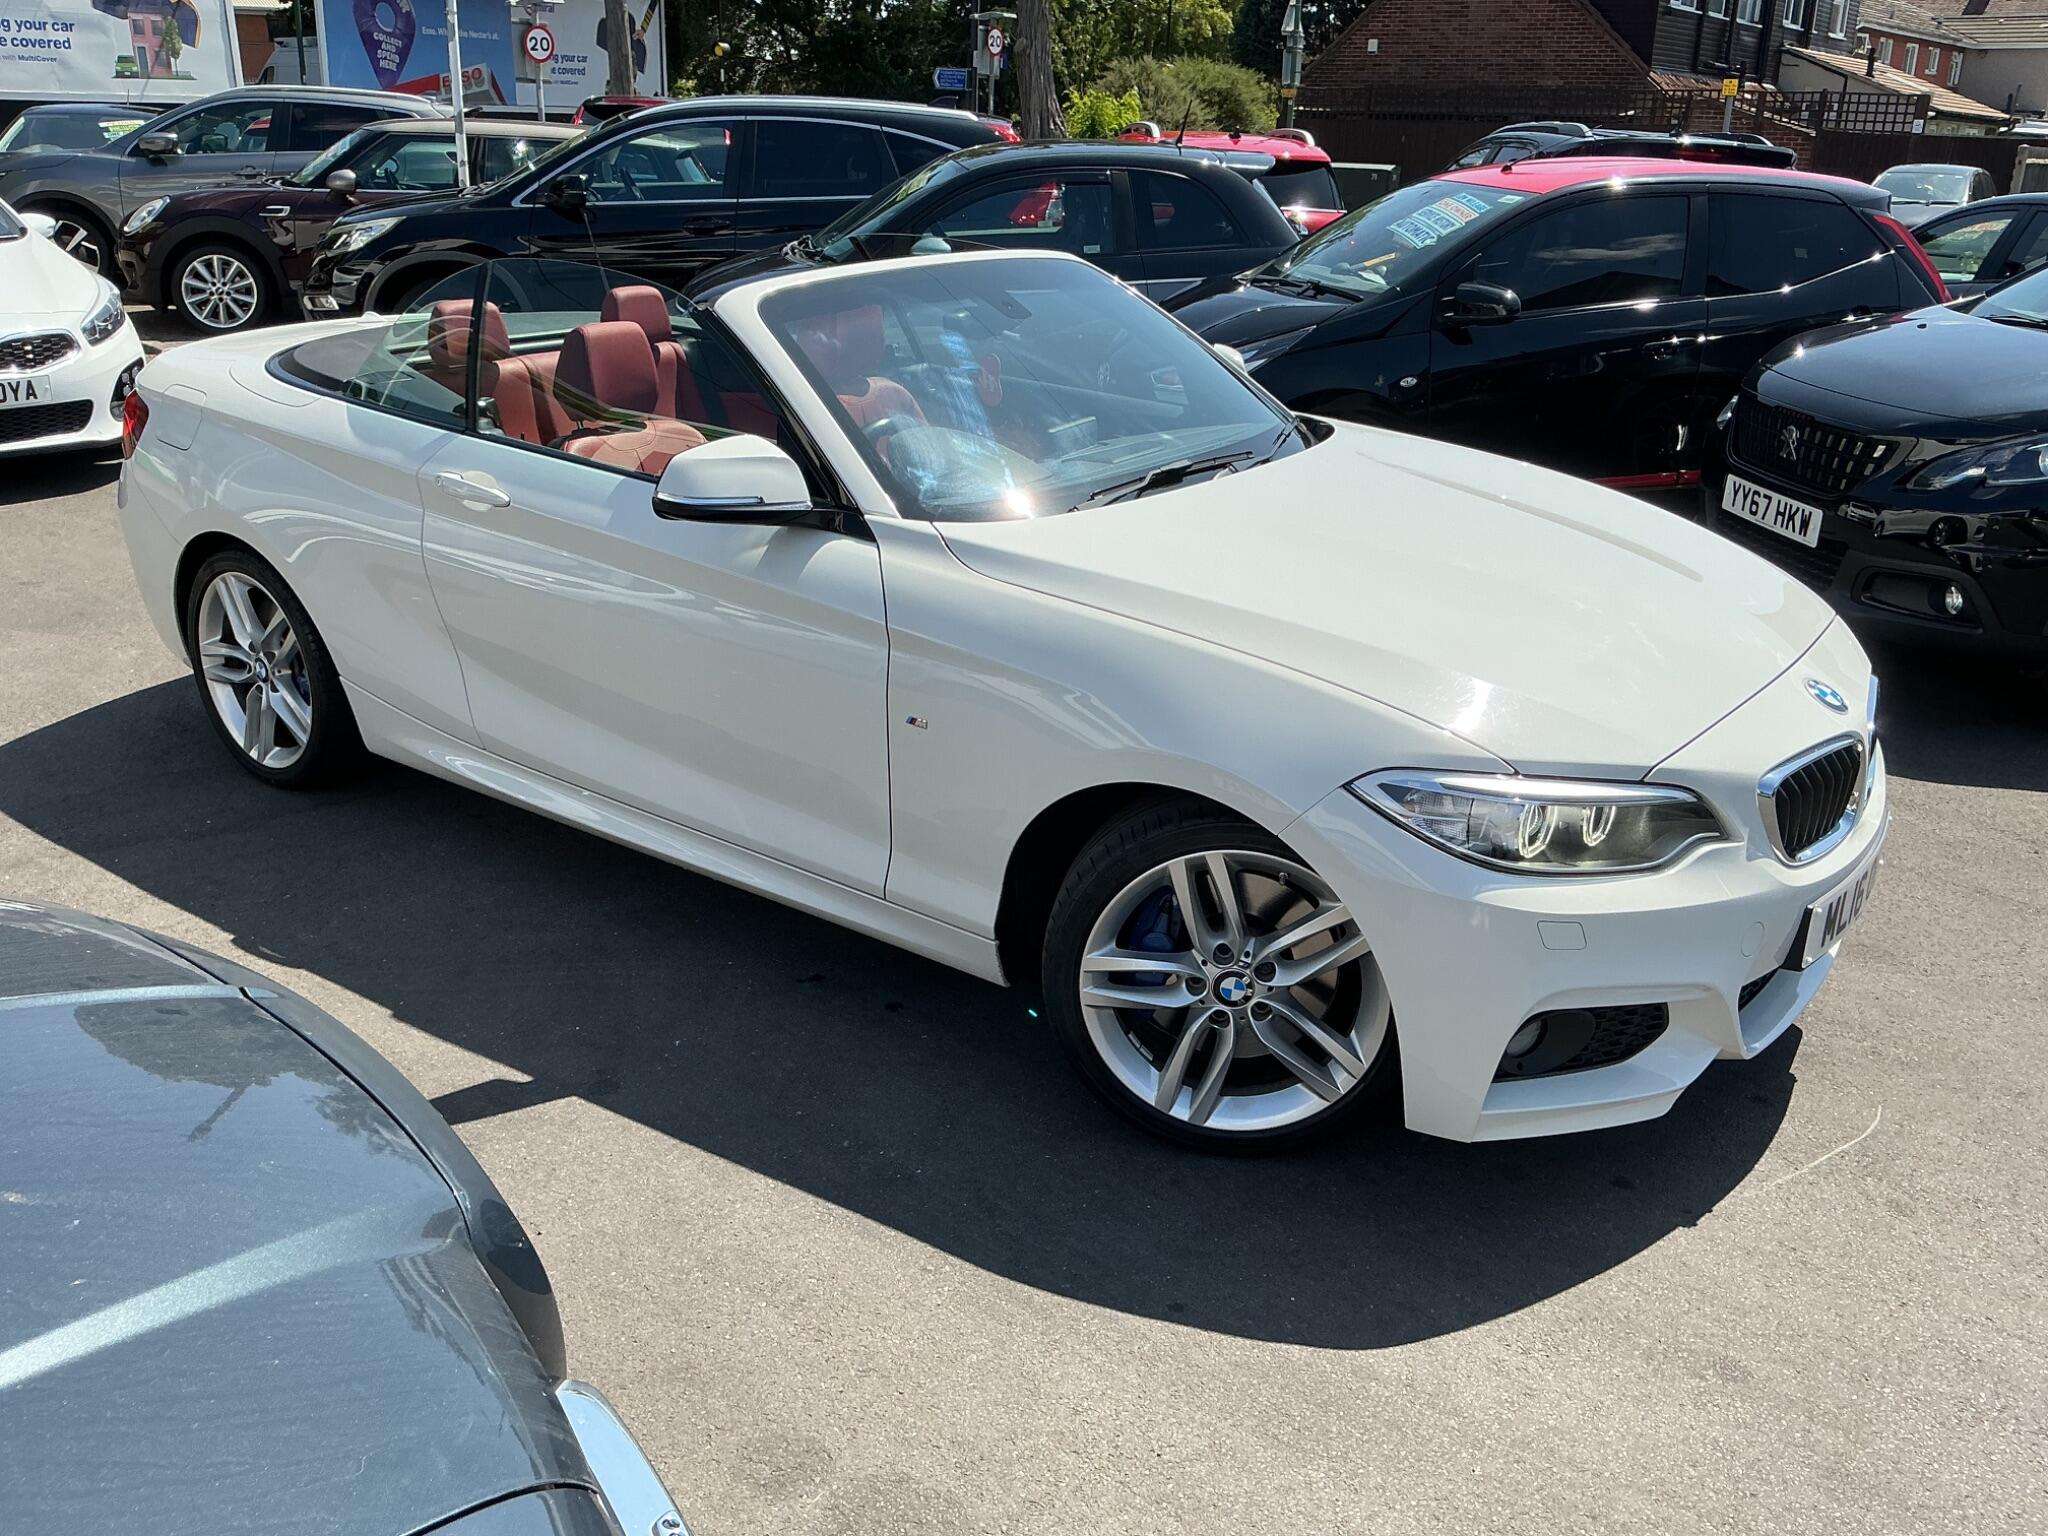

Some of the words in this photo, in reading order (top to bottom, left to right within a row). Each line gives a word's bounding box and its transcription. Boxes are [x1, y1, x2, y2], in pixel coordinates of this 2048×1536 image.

[14, 19, 48, 33] your
[51, 21, 75, 32] car
[11, 37, 71, 50] covered
[373, 31, 402, 48] COLLECT
[529, 36, 550, 52] 20
[989, 34, 1002, 48] 20
[381, 41, 396, 53] AND
[376, 49, 400, 63] SPEND
[560, 55, 575, 64] your
[576, 55, 588, 63] car
[379, 59, 398, 71] HERE
[557, 66, 586, 76] covered
[1731, 480, 1773, 521] YY67
[1773, 499, 1813, 538] HKW
[1820, 870, 1868, 948] ML16
